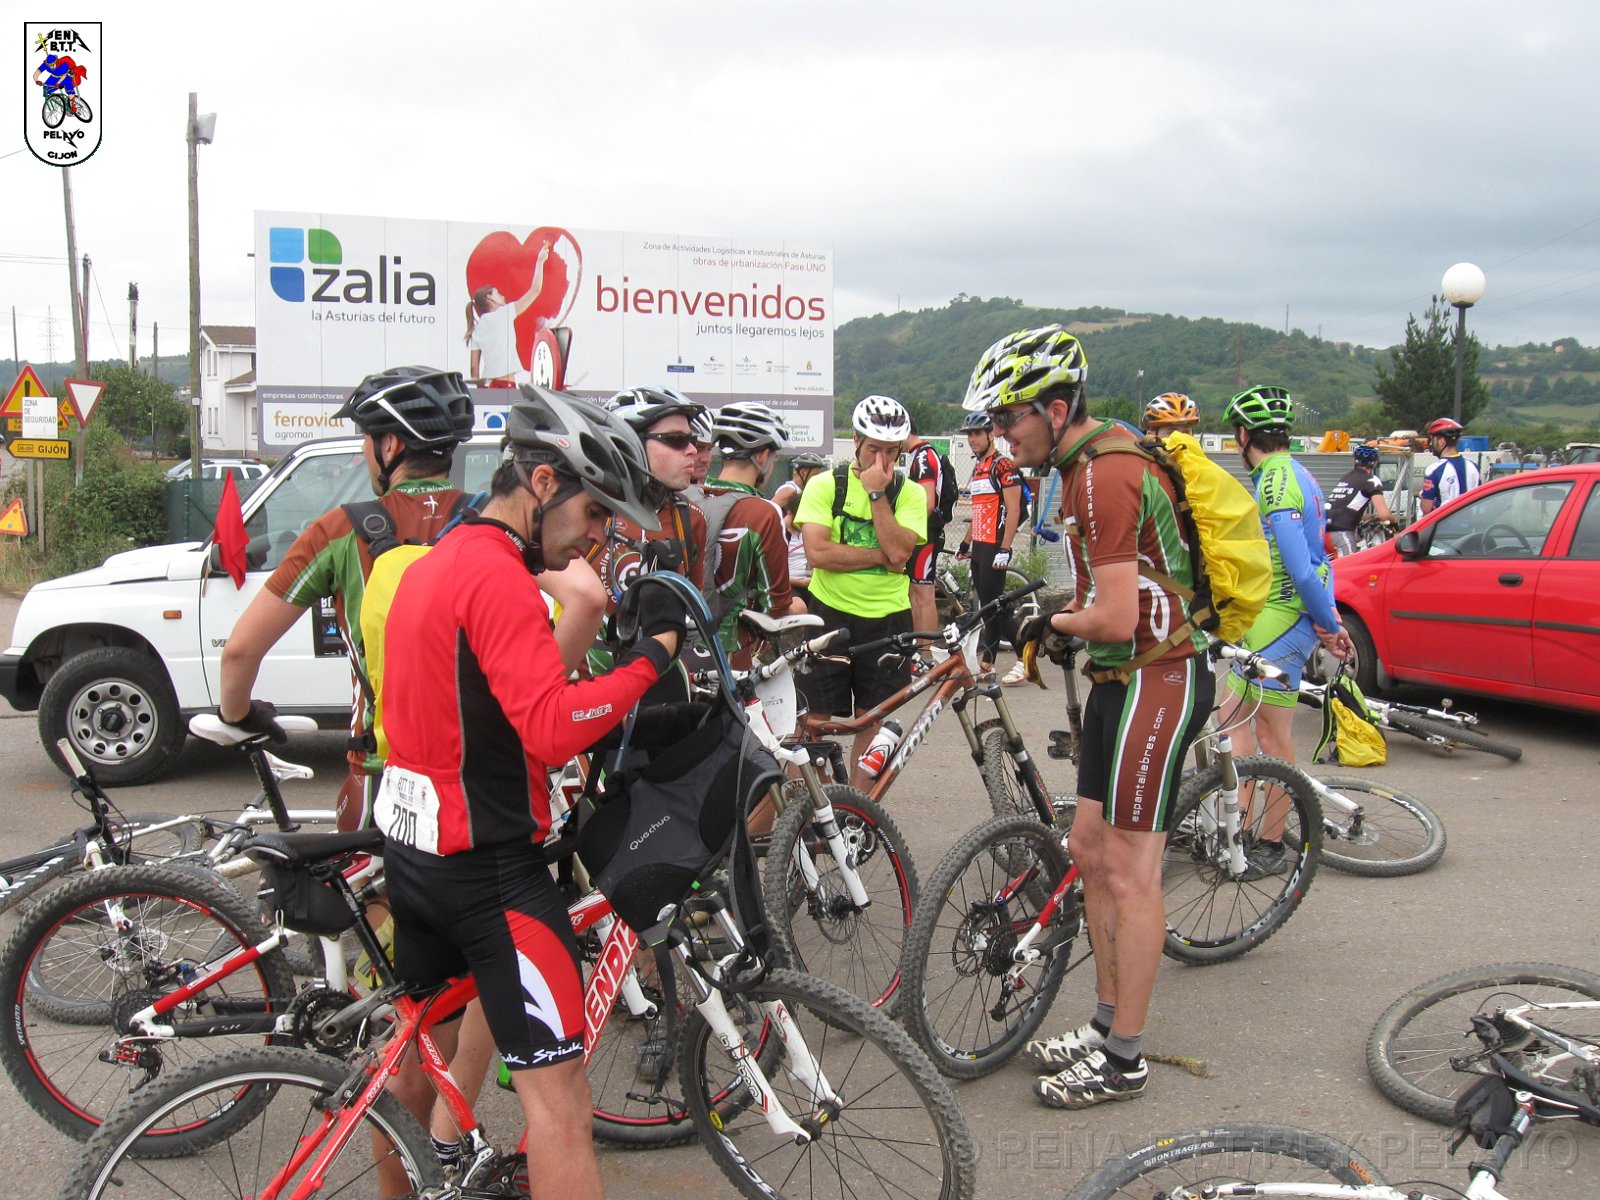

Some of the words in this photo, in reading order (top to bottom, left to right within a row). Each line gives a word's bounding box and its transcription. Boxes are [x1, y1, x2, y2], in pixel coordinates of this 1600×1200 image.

[643, 242, 661, 250] Zona
[672, 244, 712, 253] Actividades
[753, 248, 790, 258] Industriales
[800, 252, 826, 260] Asturias
[692, 257, 717, 266] obras
[718, 258, 729, 267] de
[731, 259, 783, 270] urbanización
[784, 262, 804, 271] Fase
[806, 263, 826, 272] UNO
[312, 255, 436, 305] zalia
[596, 275, 826, 321] bienvenidos
[311, 310, 322, 321] la
[325, 310, 376, 322] Asturias
[378, 311, 396, 323] del
[399, 312, 436, 324] futuro
[696, 321, 733, 336] juntos
[735, 322, 798, 338] llegaremos
[800, 324, 825, 340] lejos
[262, 392, 295, 402] empresas
[297, 392, 344, 401] constructoras
[273, 410, 345, 428] ferrovial
[275, 431, 314, 440] agroman
[38, 444, 66, 454] GIJÓN
[1132, 707, 1167, 823] espantaliebres.com
[629, 815, 671, 850] Quechua
[532, 1042, 584, 1064] Spiuk
[1151, 1142, 1207, 1164] BONTRAGER
